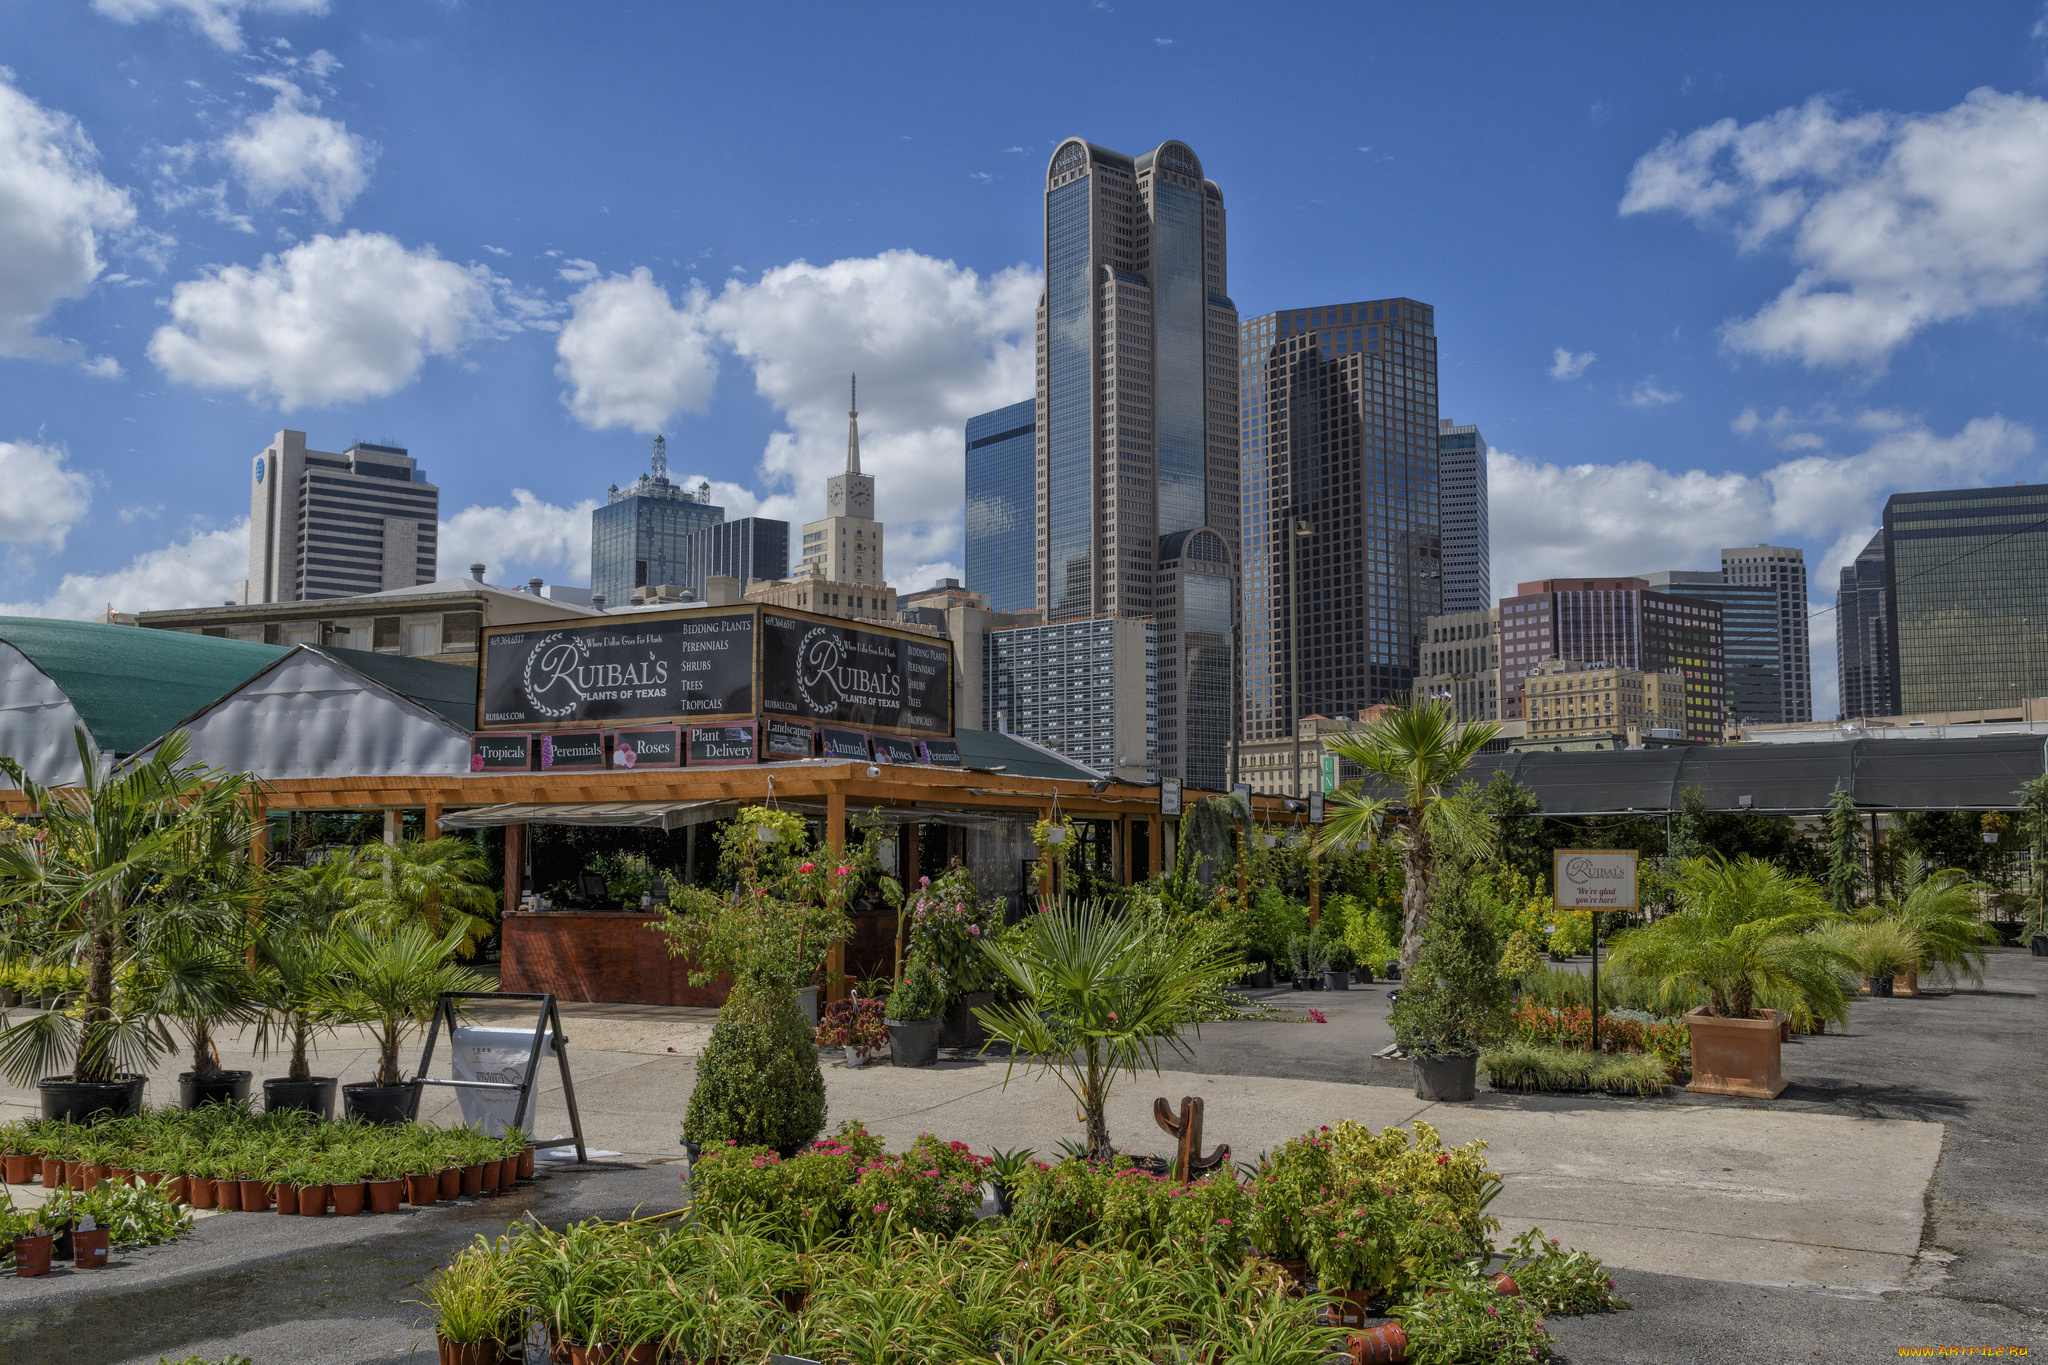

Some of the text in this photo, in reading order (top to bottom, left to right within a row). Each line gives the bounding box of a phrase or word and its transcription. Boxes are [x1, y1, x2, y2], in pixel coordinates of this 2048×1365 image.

[683, 620, 751, 635] BEDDING PLANTS
[490, 635, 525, 646] 469.364.6517
[586, 638, 602, 648] Where
[637, 635, 645, 645] For
[682, 640, 729, 653] PERENNIALS
[907, 645, 948, 662] BEDDING PLANTS
[533, 644, 668, 696] RUIBAL'S
[681, 660, 711, 672] SHRUBS
[804, 640, 900, 697] RUIBAL'S
[907, 661, 936, 676] PERENNIALS
[681, 679, 703, 691] TREES
[907, 679, 926, 691] SHRUBS
[581, 688, 667, 701] PLANTS OF TEXAS
[841, 693, 900, 709] PLANTS OF TEXAS
[681, 699, 722, 711] TROPICALS
[764, 700, 798, 712] RUIBALS.COM
[907, 696, 921, 708] TREES
[485, 712, 525, 721] RUIBALS.COM
[907, 713, 933, 727] TROPICALS
[692, 728, 720, 742] Plant
[767, 719, 812, 740] Landscaping
[480, 745, 525, 760] Tropicals
[551, 743, 602, 757] Perennials
[637, 740, 670, 754] Roses
[706, 743, 753, 759] Delivery
[831, 738, 867, 756] Annuals
[889, 745, 913, 761] Roses
[927, 749, 960, 761] Perennials
[1577, 887, 1617, 897] We're glad
[1575, 896, 1617, 905] you're here!
